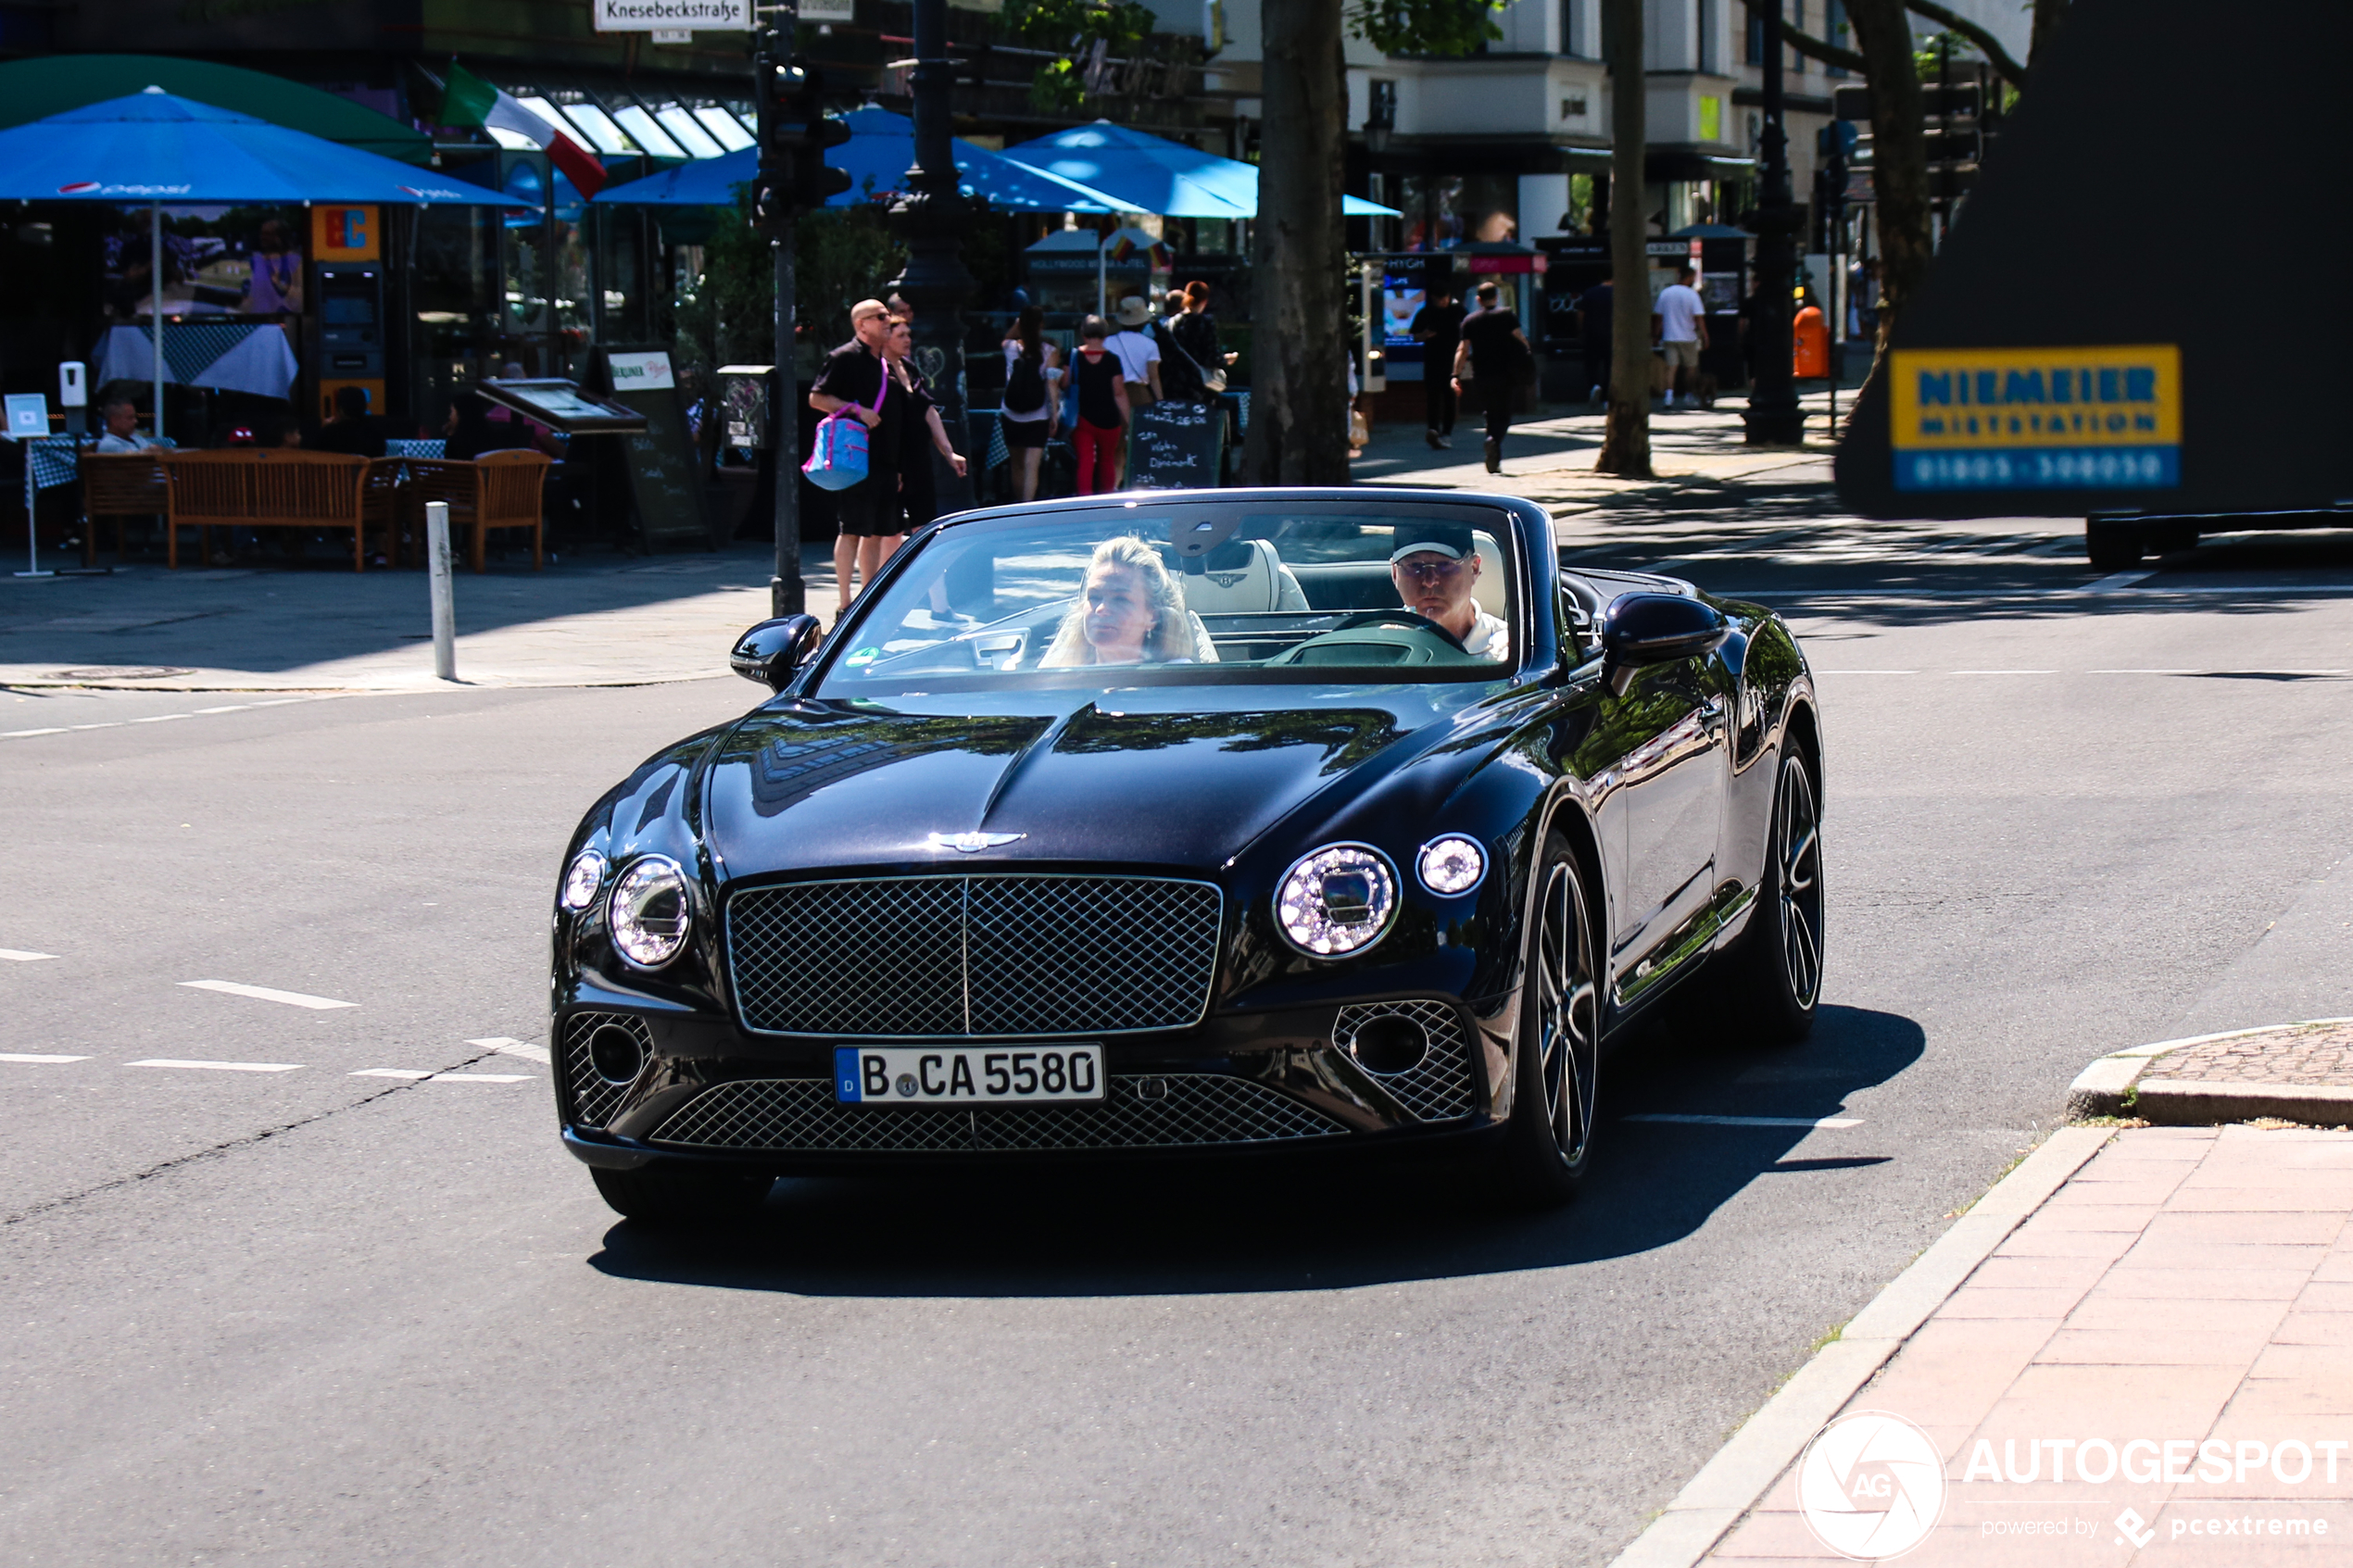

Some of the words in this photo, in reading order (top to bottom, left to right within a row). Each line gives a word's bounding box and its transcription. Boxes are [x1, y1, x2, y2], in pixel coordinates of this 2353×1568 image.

[607, 1, 740, 20] Knesebeckstraße
[1919, 368, 2157, 406] NIEMEIER
[844, 1080, 854, 1093] D
[862, 1054, 890, 1096] B
[919, 1054, 976, 1096] CA
[985, 1052, 1096, 1096] 5580
